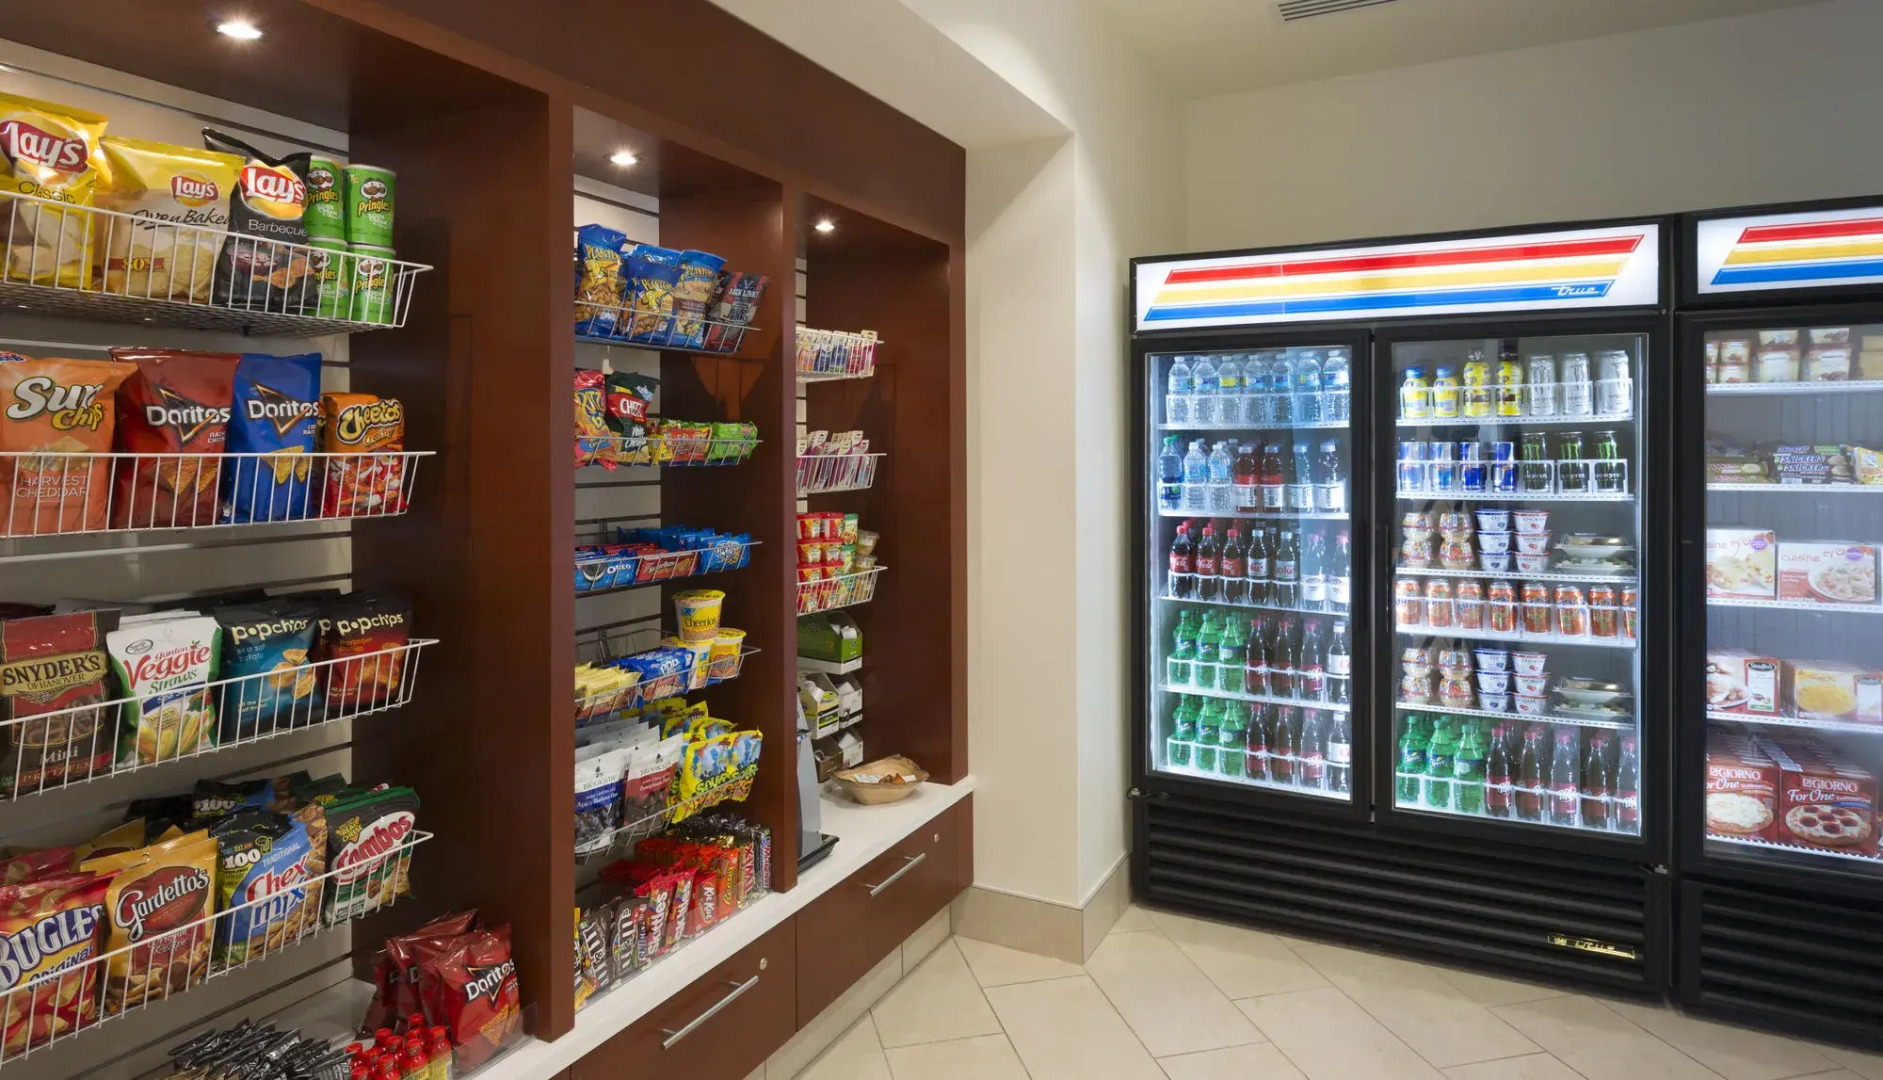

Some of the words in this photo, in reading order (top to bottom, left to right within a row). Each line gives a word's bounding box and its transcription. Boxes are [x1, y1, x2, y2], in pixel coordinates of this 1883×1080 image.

[8, 123, 83, 167] Lay's
[18, 181, 76, 204] Classic
[175, 176, 216, 199] Lay's
[247, 168, 305, 202] Lay's
[306, 189, 338, 206] Pringles
[358, 199, 389, 216] Pringles
[249, 219, 307, 236] Barbecue
[52, 403, 103, 431] Chips
[147, 404, 230, 427] Doritos
[248, 400, 318, 419] Doritos
[338, 399, 402, 442] Cheetos
[1781, 455, 1825, 463] SNICKERS
[1784, 464, 1828, 472] SNICKERS
[20, 475, 88, 486] HARVEST
[16, 487, 87, 498] CHEDDAR
[1706, 541, 1727, 550] sine
[1781, 553, 1821, 562] cuisine
[607, 564, 631, 574] OREO
[231, 618, 308, 645] popchips
[337, 613, 403, 635] popchips
[685, 617, 716, 629] Cheerios
[155, 647, 188, 661] Garden
[3, 655, 101, 686] SNYDER'S
[124, 646, 211, 690] Veggie
[27, 681, 40, 690] OF
[42, 673, 85, 688] HANOVER
[149, 670, 197, 694] Straws
[39, 746, 78, 765] Mini
[22, 761, 90, 783] PRETZELS
[1710, 766, 1761, 781] DIGIORNO
[696, 773, 727, 793] SOUR
[1706, 782, 1716, 790] or
[1716, 778, 1739, 790] One
[1803, 777, 1858, 792] DIGIORNO
[1788, 789, 1808, 802] For
[1809, 789, 1834, 802] One
[342, 823, 357, 835] REAL
[263, 843, 300, 867] TRADITIONAL
[337, 815, 411, 875] Combos
[246, 852, 308, 903] Chex
[115, 869, 209, 941] Gardetto's
[253, 877, 306, 928] mix
[648, 892, 668, 954] Skittles
[465, 959, 515, 1001] Doritos
